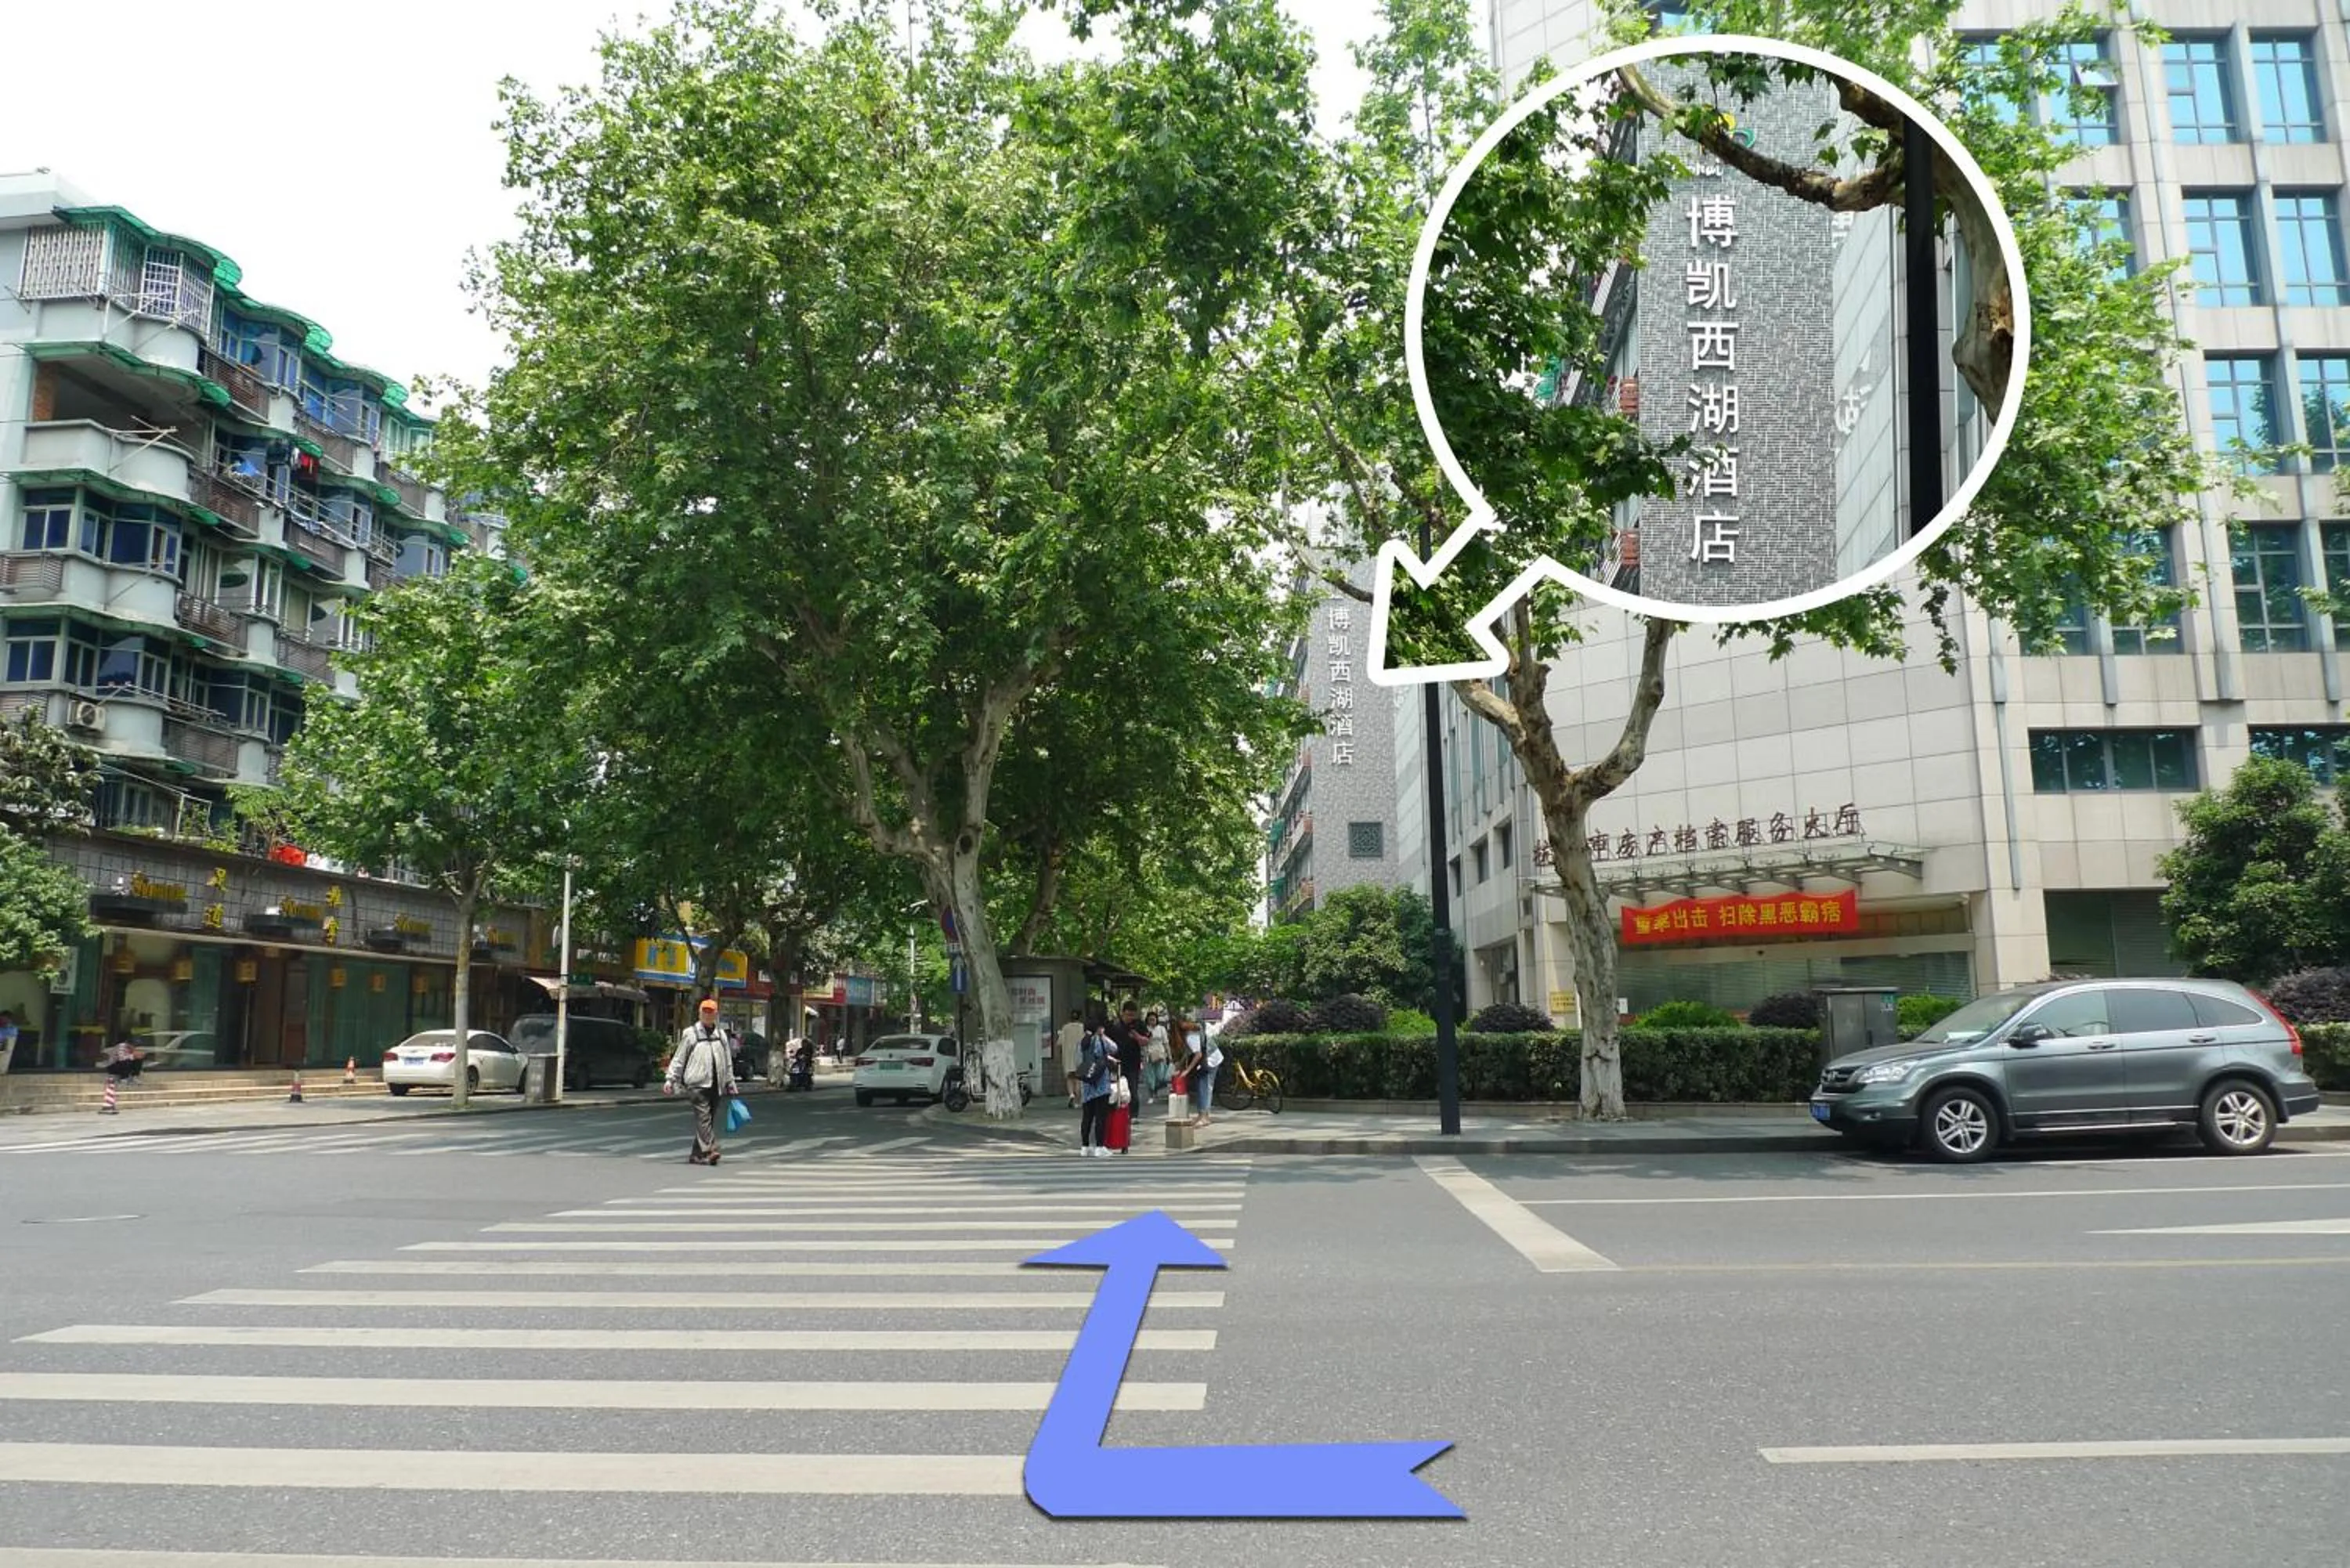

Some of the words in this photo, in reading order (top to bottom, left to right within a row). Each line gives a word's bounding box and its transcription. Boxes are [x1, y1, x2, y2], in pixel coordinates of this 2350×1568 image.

[1685, 194, 1740, 565] 博凯西湖酒店
[1328, 607, 1354, 766] 博凯西湖酒店
[1533, 801, 1860, 866] 杭市房产档案服务大厅
